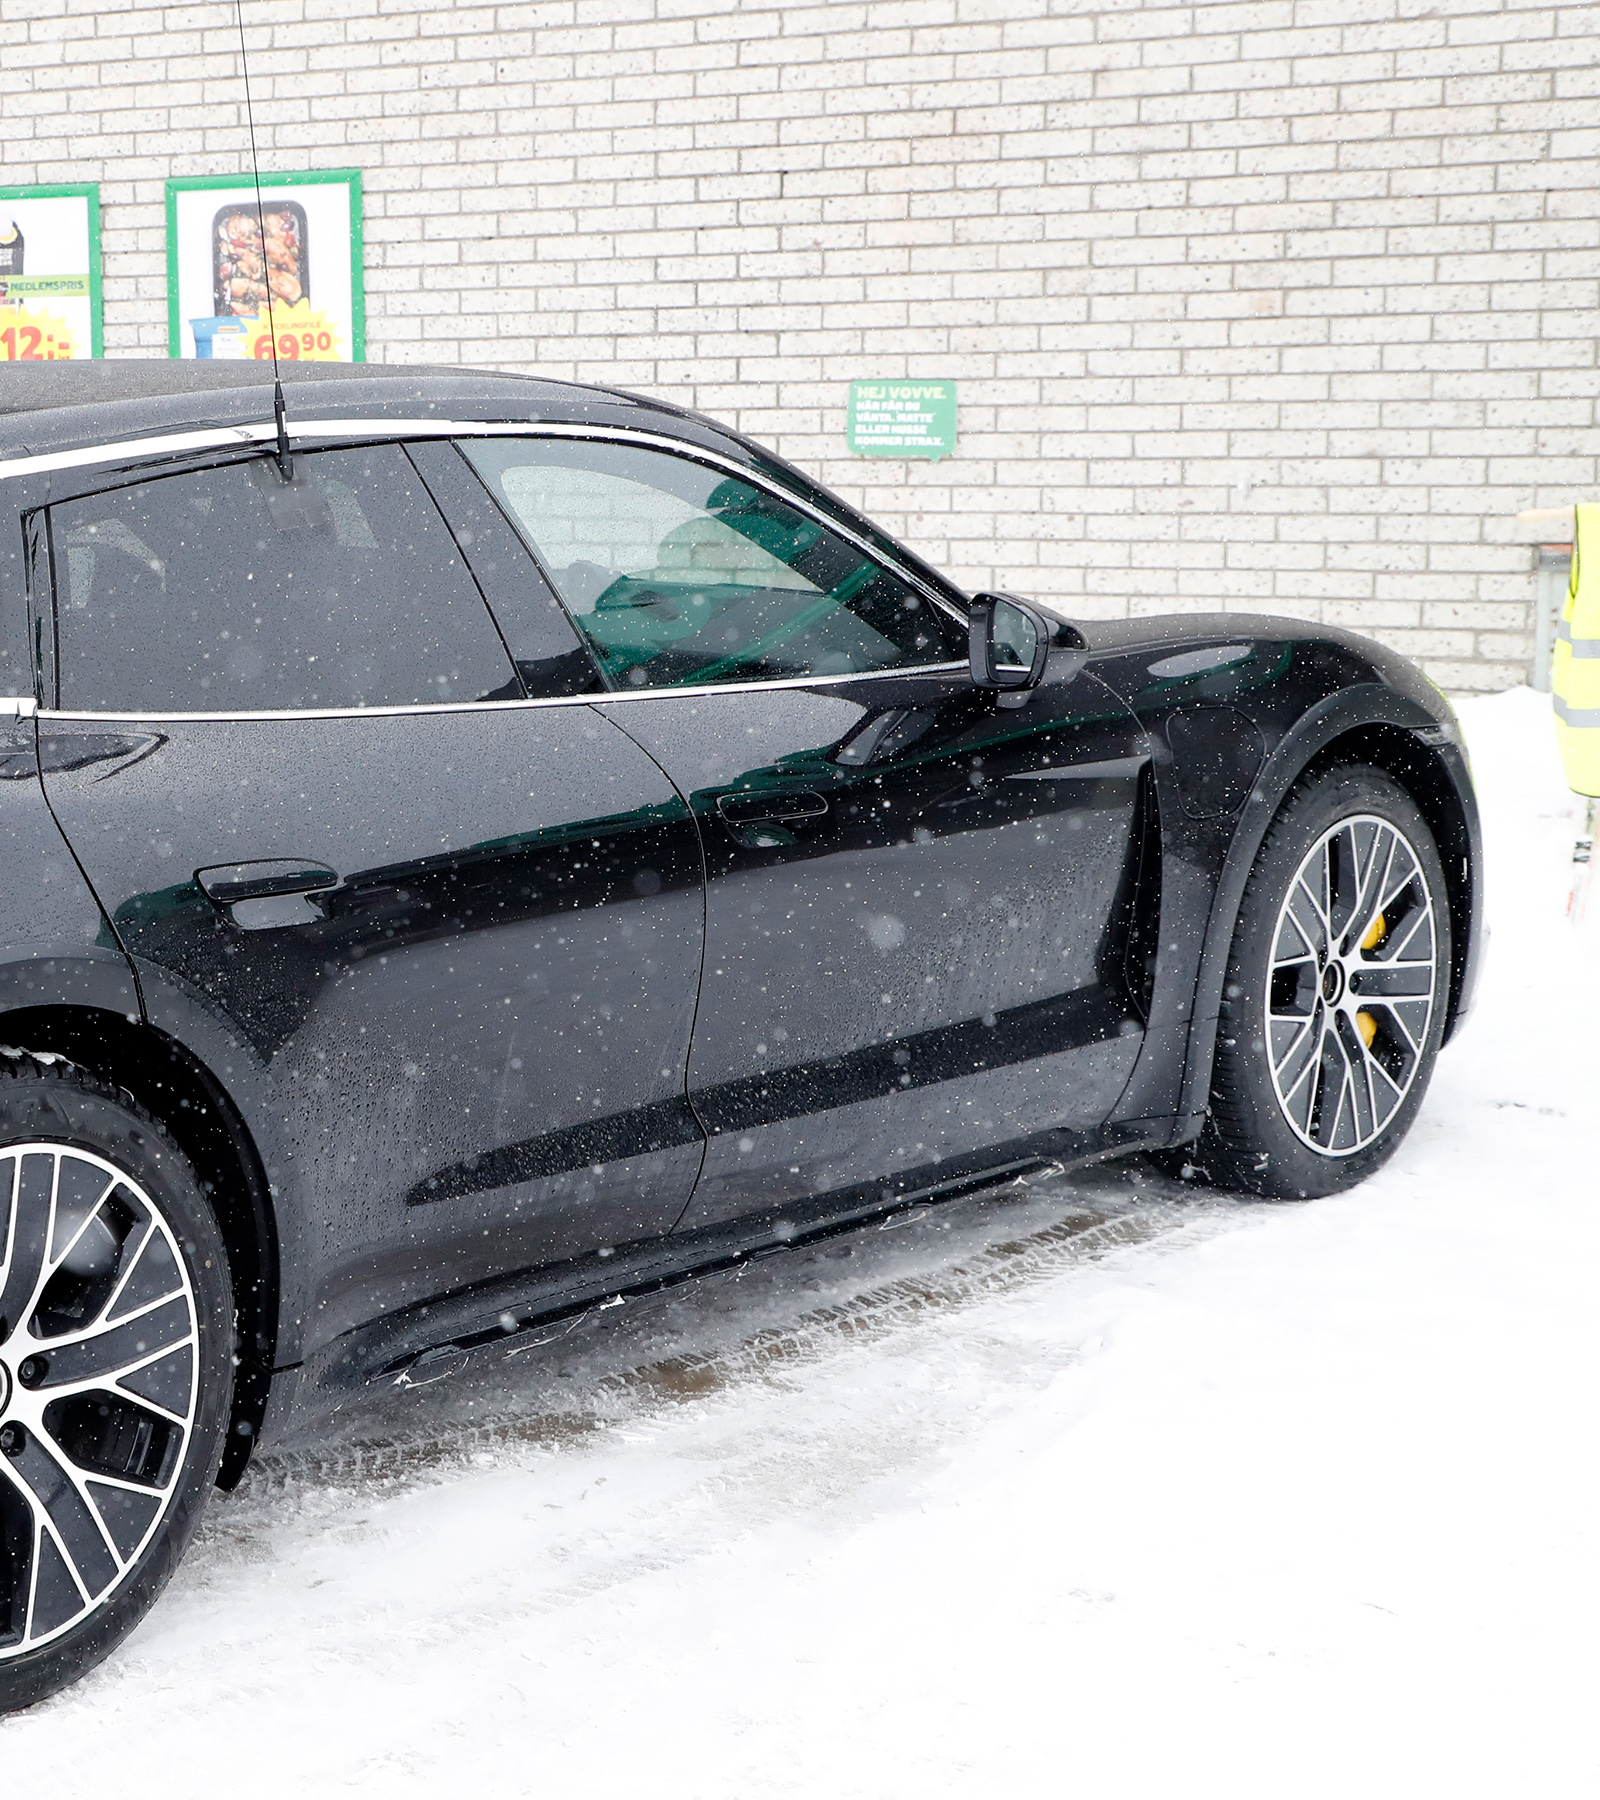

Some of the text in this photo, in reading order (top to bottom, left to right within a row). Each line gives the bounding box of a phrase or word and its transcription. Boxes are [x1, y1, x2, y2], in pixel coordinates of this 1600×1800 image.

[10, 280, 84, 291] MEDLEMSPRIS
[857, 386, 947, 400] HEJ VOVVE.
[881, 399, 903, 411] FÅR
[905, 401, 920, 411] DU
[896, 413, 933, 423] MATTE
[855, 424, 890, 434] ELLER
[854, 436, 903, 446] KOMMER
